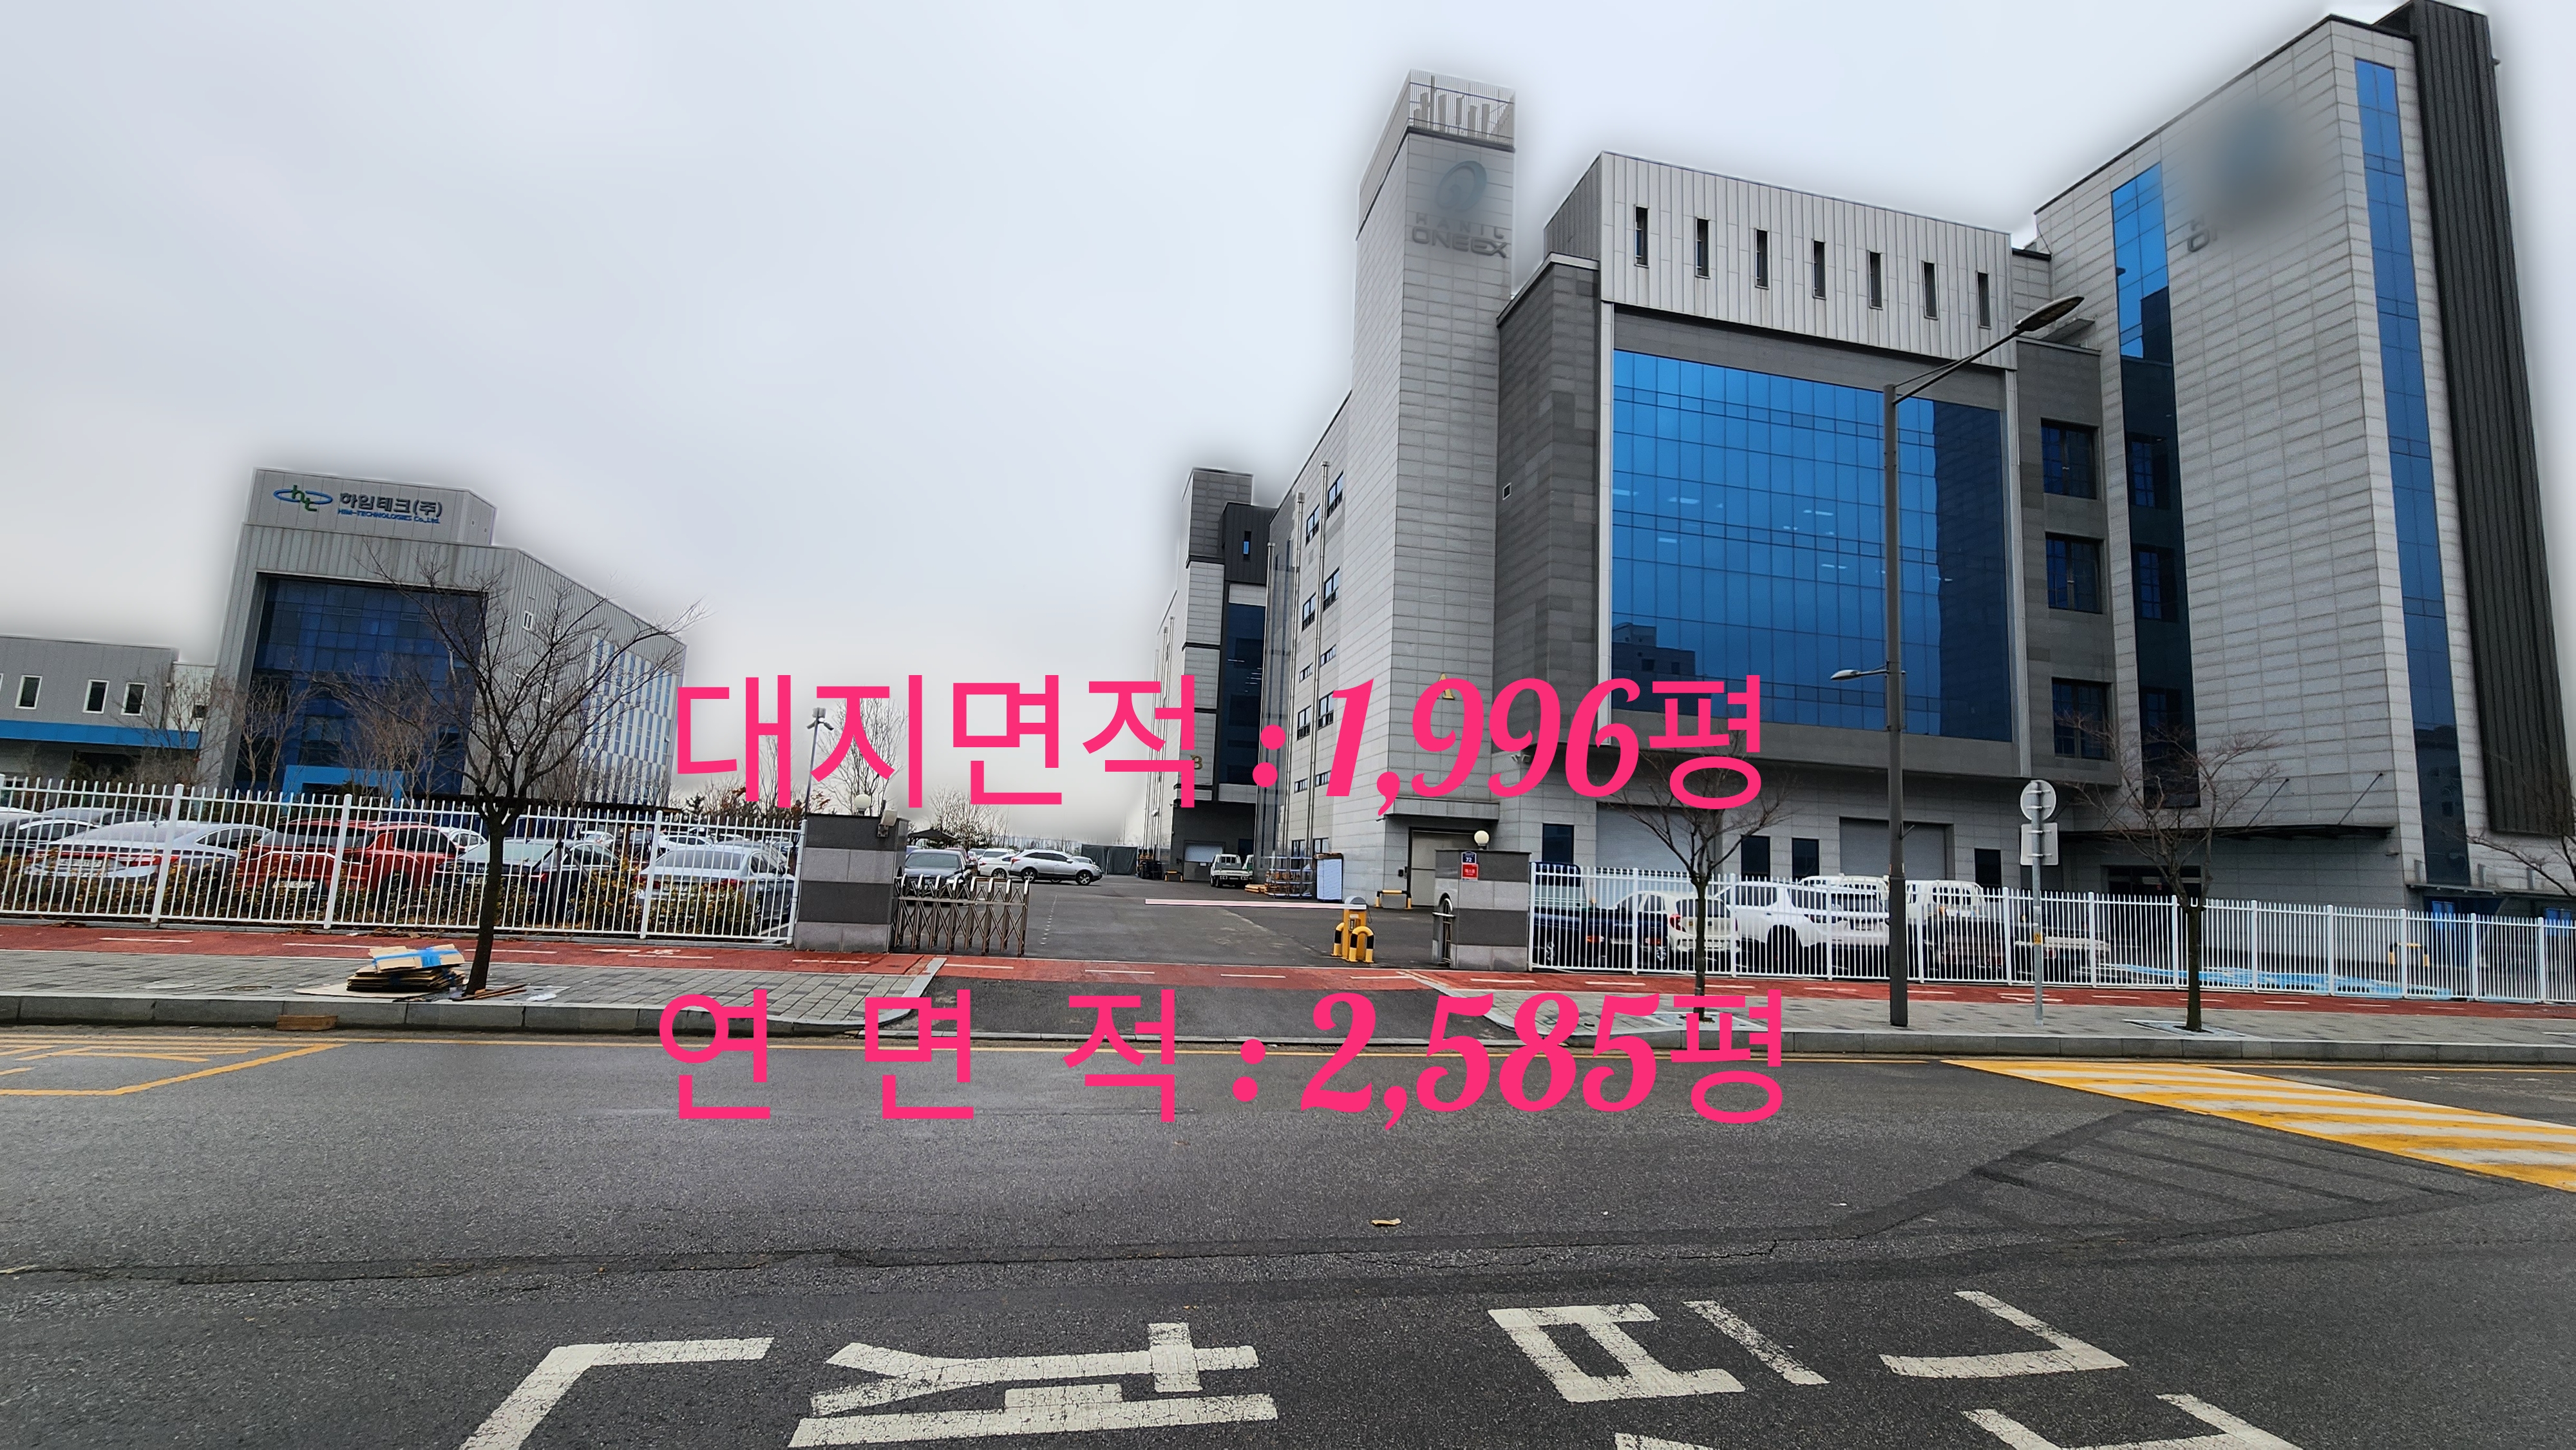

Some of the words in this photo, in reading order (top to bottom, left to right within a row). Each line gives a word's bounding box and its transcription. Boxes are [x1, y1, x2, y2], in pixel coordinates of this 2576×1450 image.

[1416, 211, 1504, 240] HANIL
[1412, 226, 1508, 258] ONEEX
[337, 508, 413, 522] HIM-TECHNOLOGIES
[339, 492, 442, 517] 하임테크(주)
